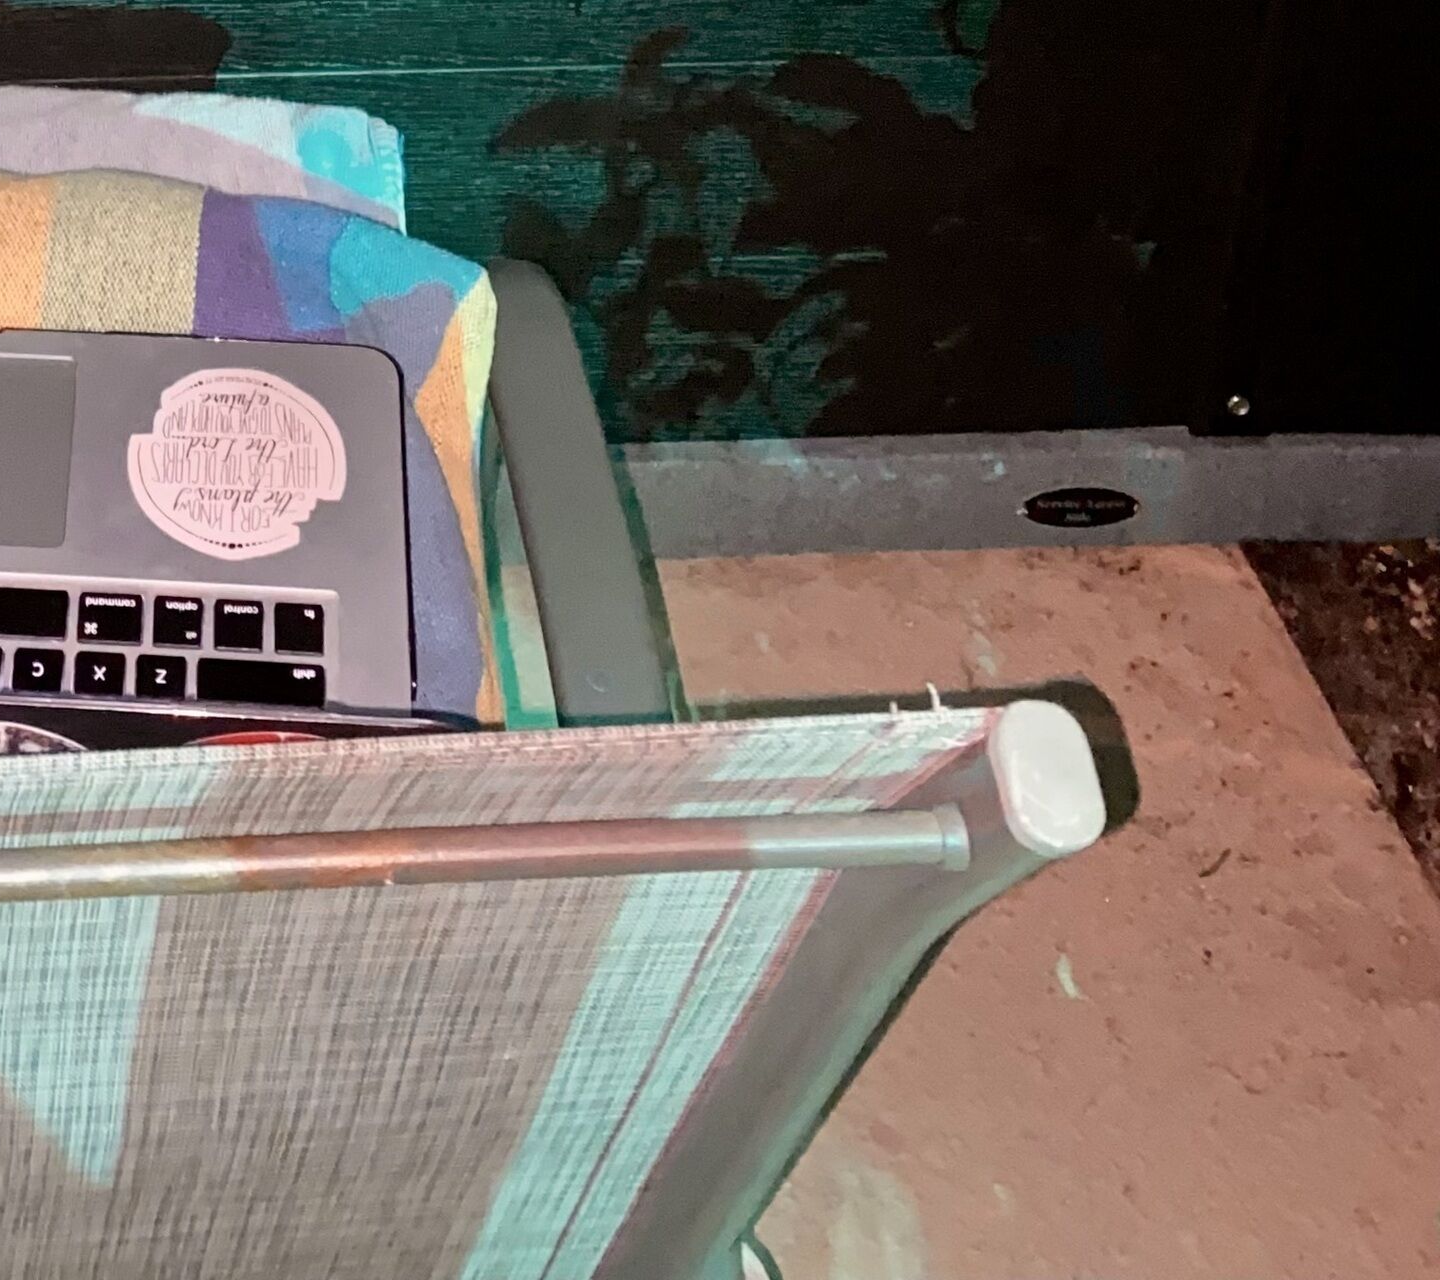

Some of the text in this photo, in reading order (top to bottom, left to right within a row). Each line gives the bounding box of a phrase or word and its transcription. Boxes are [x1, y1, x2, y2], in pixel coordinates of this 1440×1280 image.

[259, 395, 270, 407] a
[163, 402, 188, 438] AND
[274, 403, 312, 444] PLANS
[245, 437, 282, 463] the
[150, 442, 216, 485] DECLARES
[219, 454, 243, 485] YOU
[279, 448, 317, 489] HAVE
[198, 479, 260, 511] plans
[264, 491, 300, 518] the
[179, 499, 223, 530] KNOW
[241, 506, 270, 533] FOR
[85, 596, 137, 608] command
[165, 600, 198, 612] option
[223, 604, 259, 615] control
[304, 608, 315, 620] fn
[31, 662, 45, 677] C
[93, 665, 107, 681] X
[155, 668, 167, 684] Z
[293, 668, 316, 680] shift
